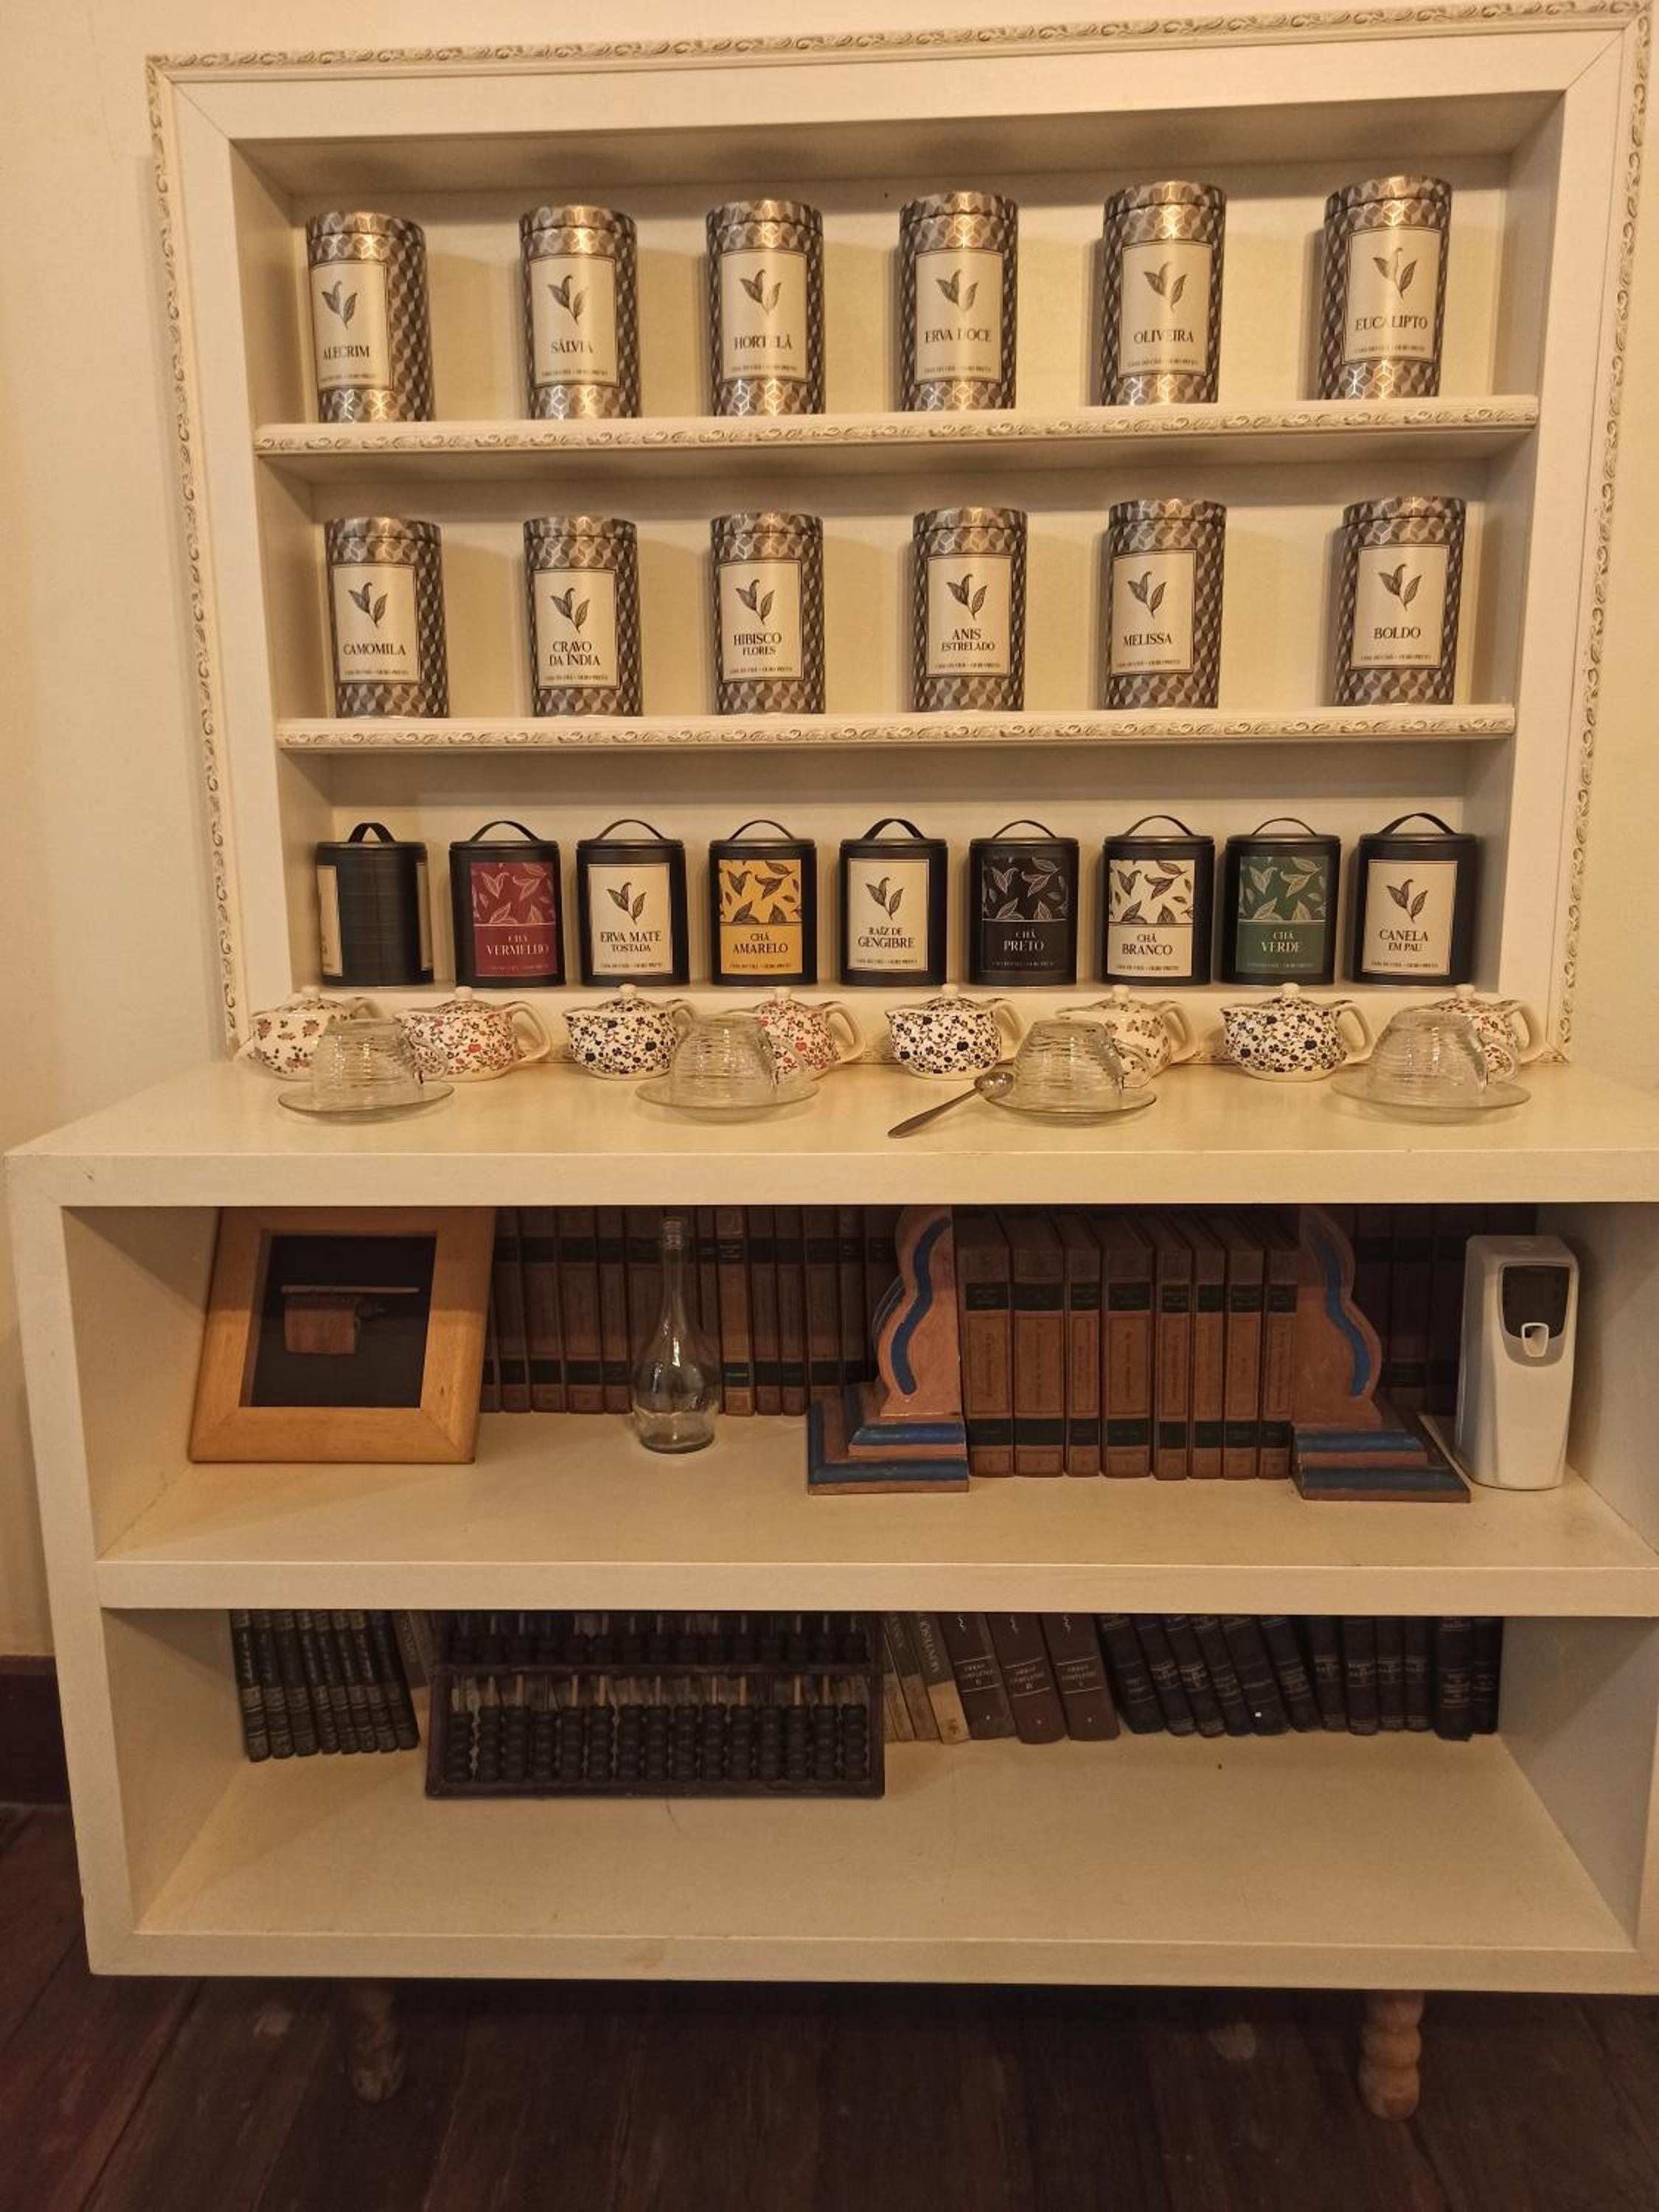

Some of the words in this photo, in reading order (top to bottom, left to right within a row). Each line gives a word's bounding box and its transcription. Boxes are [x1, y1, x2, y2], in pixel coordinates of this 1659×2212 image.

[733, 333, 793, 350] HORTLÃ
[924, 330, 953, 344] ERVA
[1133, 330, 1194, 344] OLIVIRA
[323, 345, 369, 361] ALECRIM
[733, 632, 782, 647] HIBISCO
[952, 627, 982, 641] ANIS
[1123, 632, 1172, 647] MELISSA
[1374, 626, 1422, 640] BOLDO
[343, 642, 407, 655] CAMOMILA
[552, 641, 592, 653] CRAVO
[742, 646, 776, 655] FLORES
[941, 641, 995, 652] ESTRELADO
[549, 654, 563, 667] DA
[600, 931, 625, 943] ERVA
[629, 930, 661, 943] MATE
[750, 931, 770, 942] CHÁ
[891, 927, 903, 936] DE
[1136, 932, 1157, 943] CHÁ
[1379, 928, 1429, 942] CANELA
[612, 943, 652, 953] TOSTADA
[732, 942, 788, 954] AMARELO
[857, 936, 916, 949] GENGIBRE
[1003, 939, 1045, 952] PRETO
[1262, 942, 1302, 953] VERDE
[1388, 942, 1402, 953] EM
[1404, 942, 1422, 953] PAU
[485, 944, 550, 956] VERMELHO
[1121, 943, 1174, 956] BRANCO
